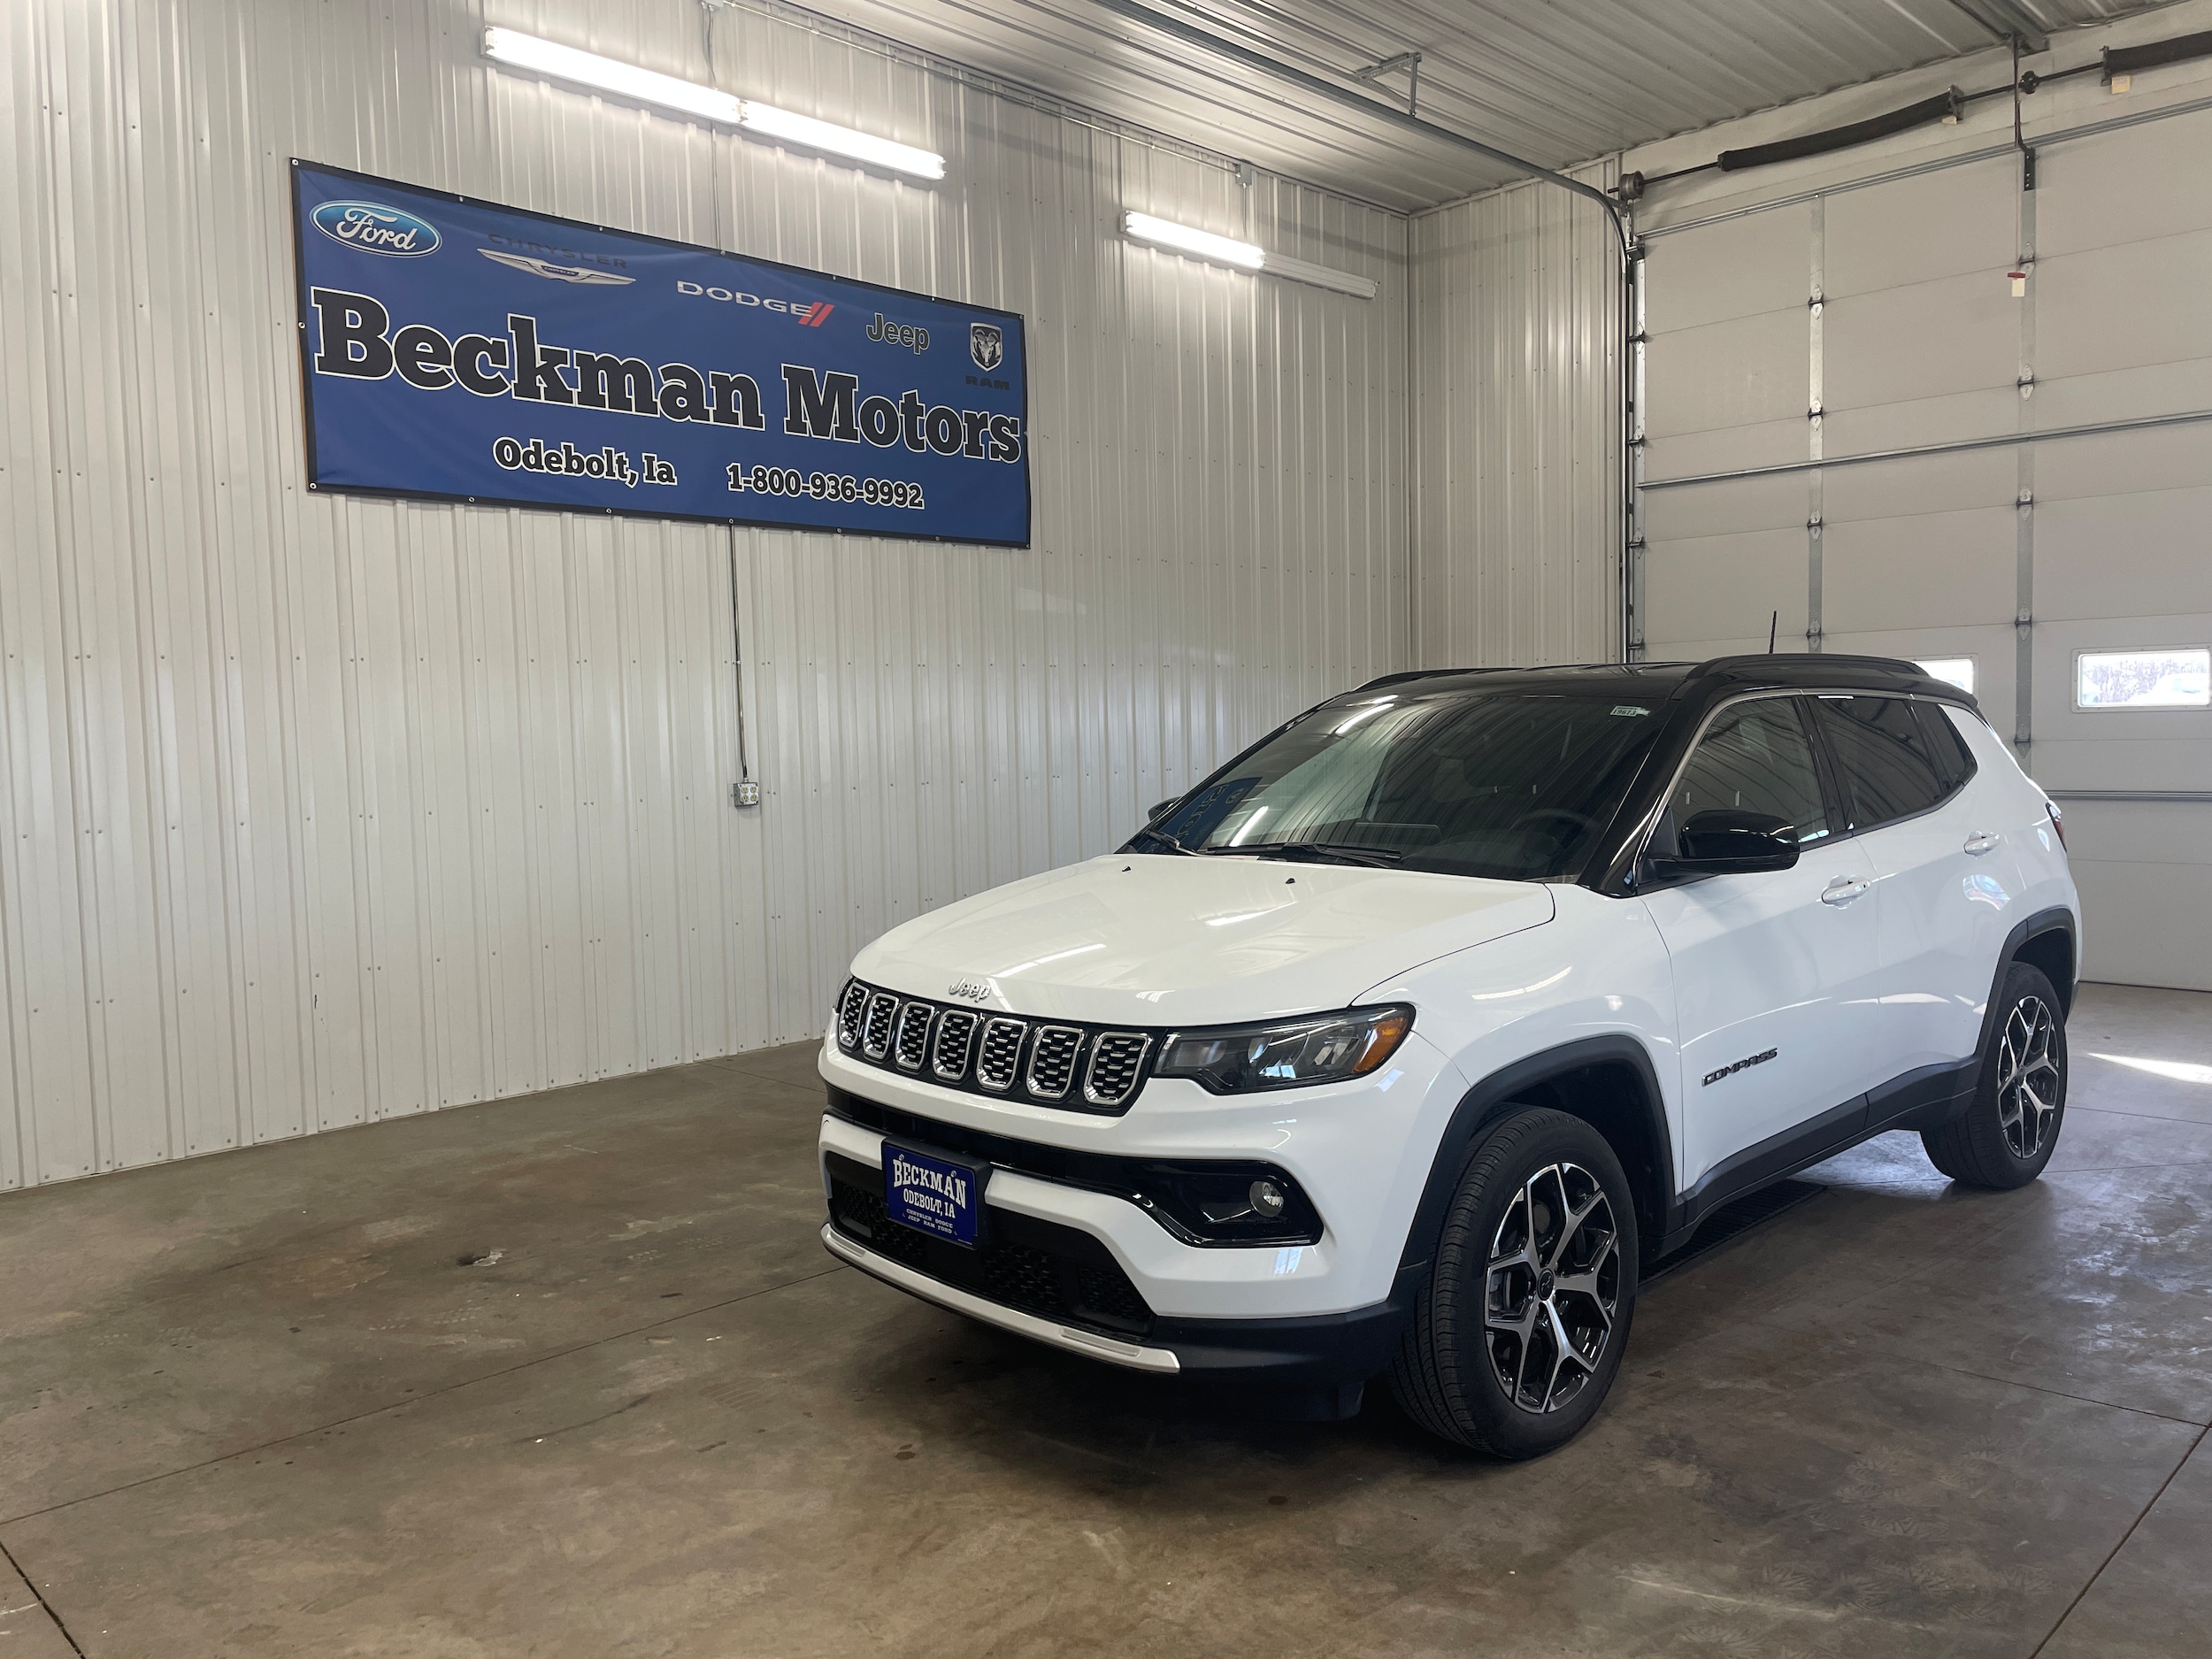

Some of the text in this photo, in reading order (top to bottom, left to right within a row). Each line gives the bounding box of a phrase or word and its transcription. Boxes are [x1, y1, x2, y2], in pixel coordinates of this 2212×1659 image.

[335, 207, 417, 250] Ford
[488, 234, 627, 269] CHRYSLER
[677, 280, 813, 318] DODGE
[866, 312, 930, 355] Jeep
[310, 285, 1023, 464] Beckman Motors
[965, 375, 1010, 390] RAM
[493, 436, 925, 510] Odebolt, Ia 1-800-936-9992
[949, 977, 991, 1002] Jeep
[1701, 1048, 1778, 1087] COMPASS
[893, 1158, 966, 1210] BECKMAN
[903, 1188, 956, 1219] ODEBOLT, IA
[938, 1225, 953, 1234] FORD
